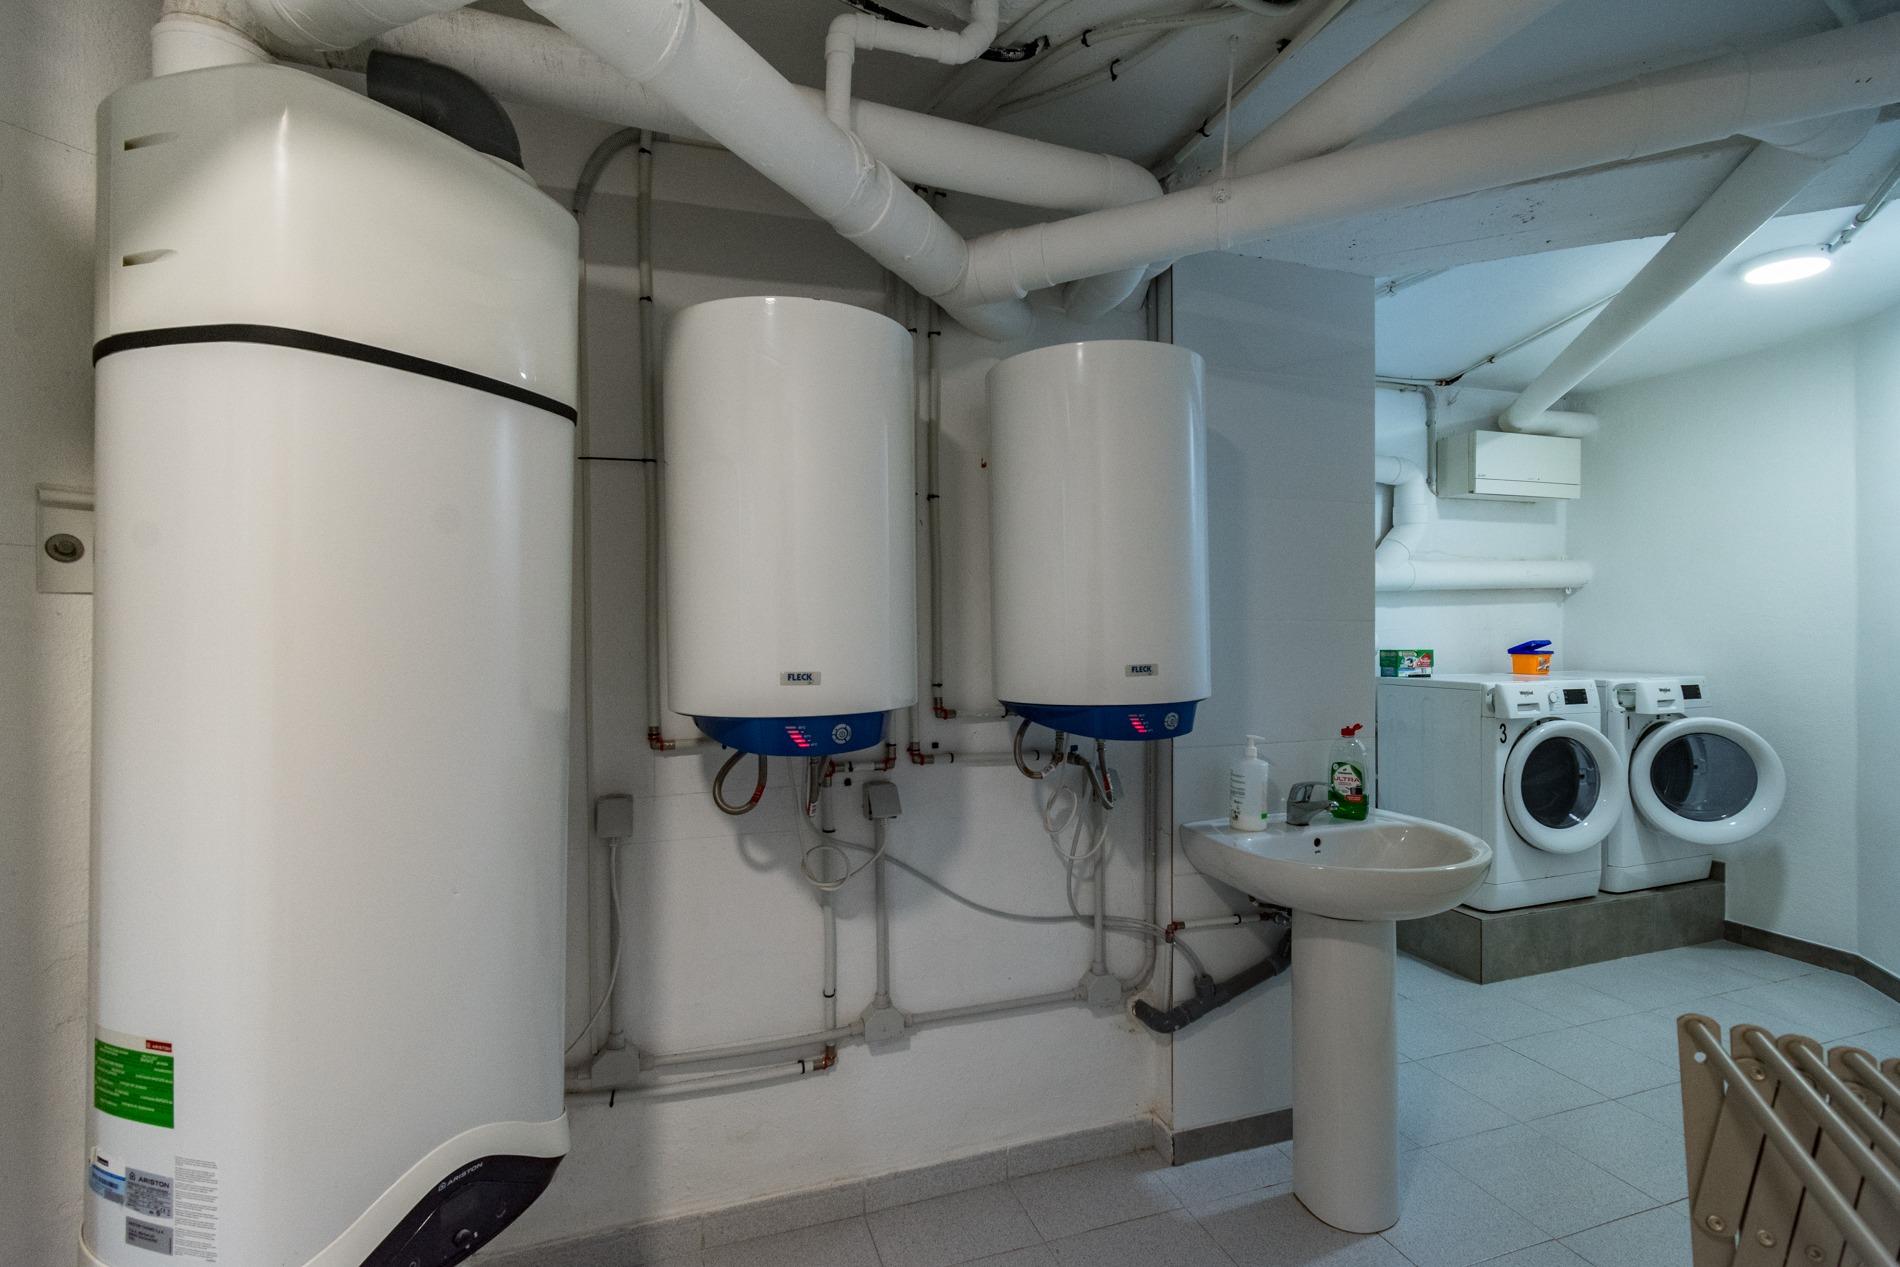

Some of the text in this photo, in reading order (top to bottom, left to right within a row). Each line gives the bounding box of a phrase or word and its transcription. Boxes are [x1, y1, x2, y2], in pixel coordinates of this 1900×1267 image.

[1131, 665, 1152, 673] FLECK
[787, 673, 812, 681] FLECK
[1499, 723, 1507, 744] 3
[447, 1162, 483, 1186] ARISTON
[138, 1176, 170, 1189] ARISTON
